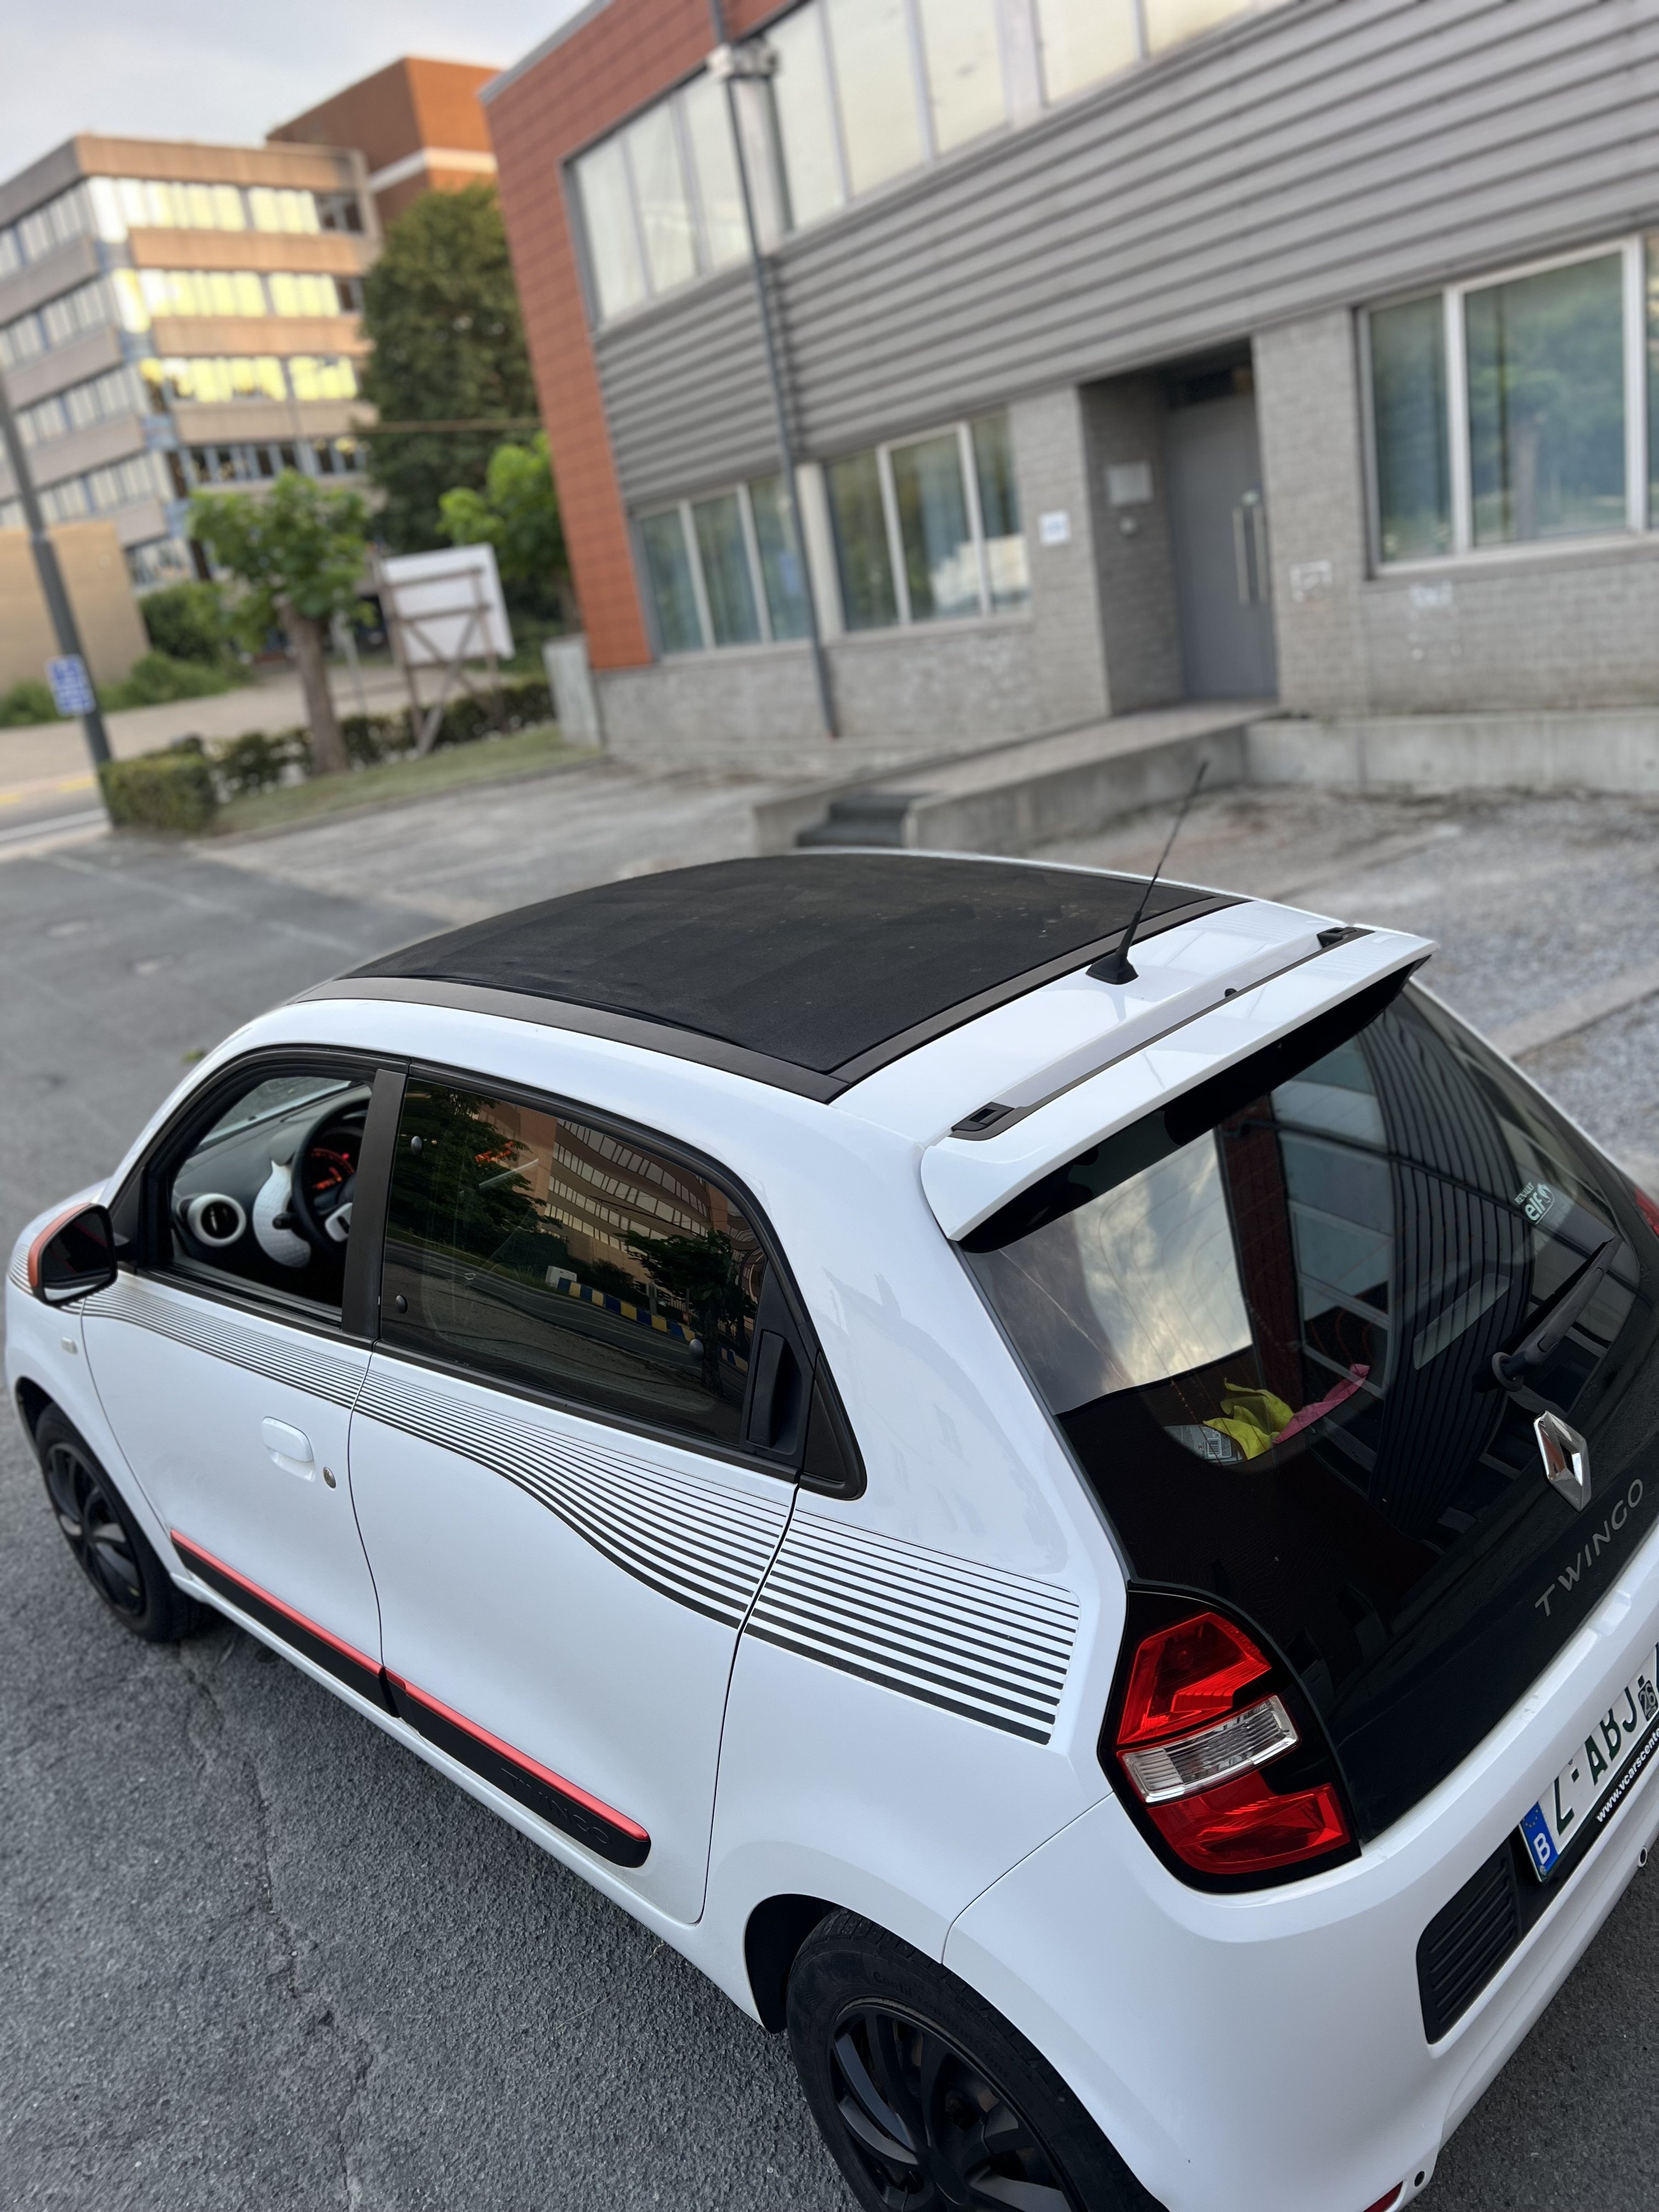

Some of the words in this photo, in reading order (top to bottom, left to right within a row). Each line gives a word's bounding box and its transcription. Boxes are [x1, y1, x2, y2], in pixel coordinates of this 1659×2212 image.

[1525, 1192, 1546, 1221] elf
[1534, 1479, 1643, 1616] TWINGO
[1533, 1832, 1551, 1865] B
